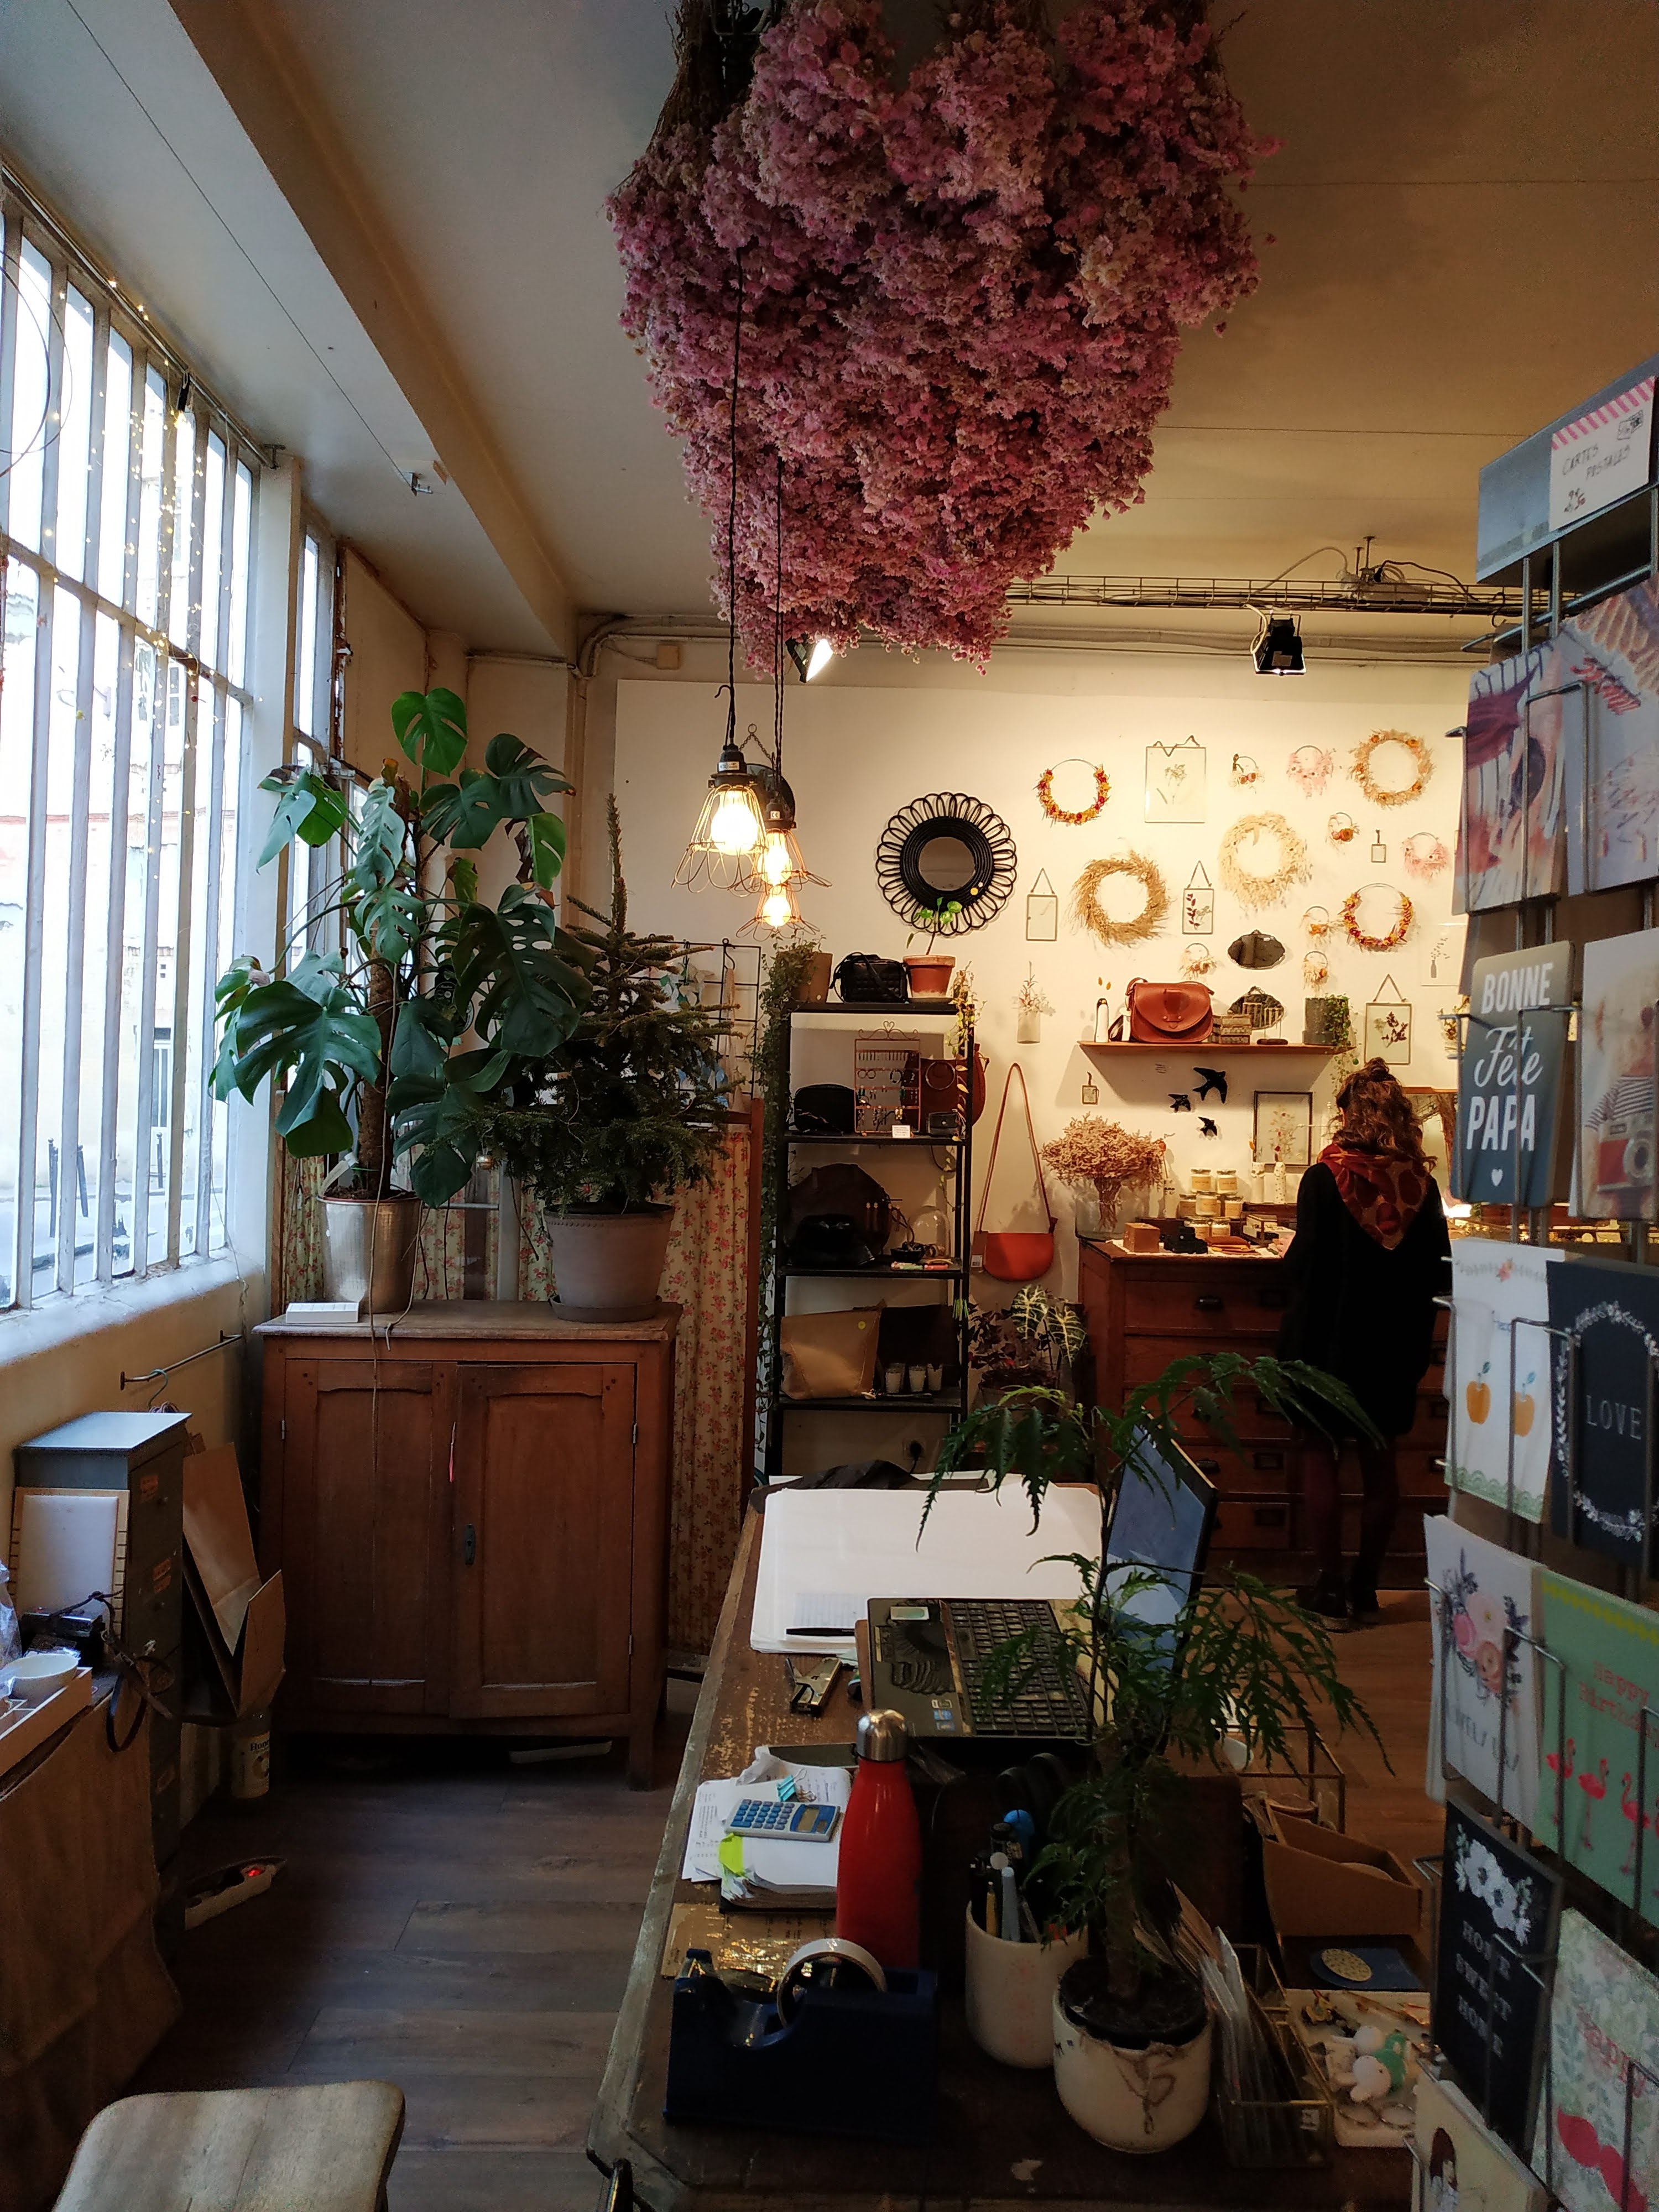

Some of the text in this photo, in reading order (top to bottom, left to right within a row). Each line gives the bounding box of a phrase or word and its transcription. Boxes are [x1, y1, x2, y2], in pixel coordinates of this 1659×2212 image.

[1562, 444, 1599, 476] CARTES
[1481, 962, 1553, 1014] BONNE
[1466, 1094, 1536, 1151] PAPA
[1586, 1395, 1642, 1440] LOVE
